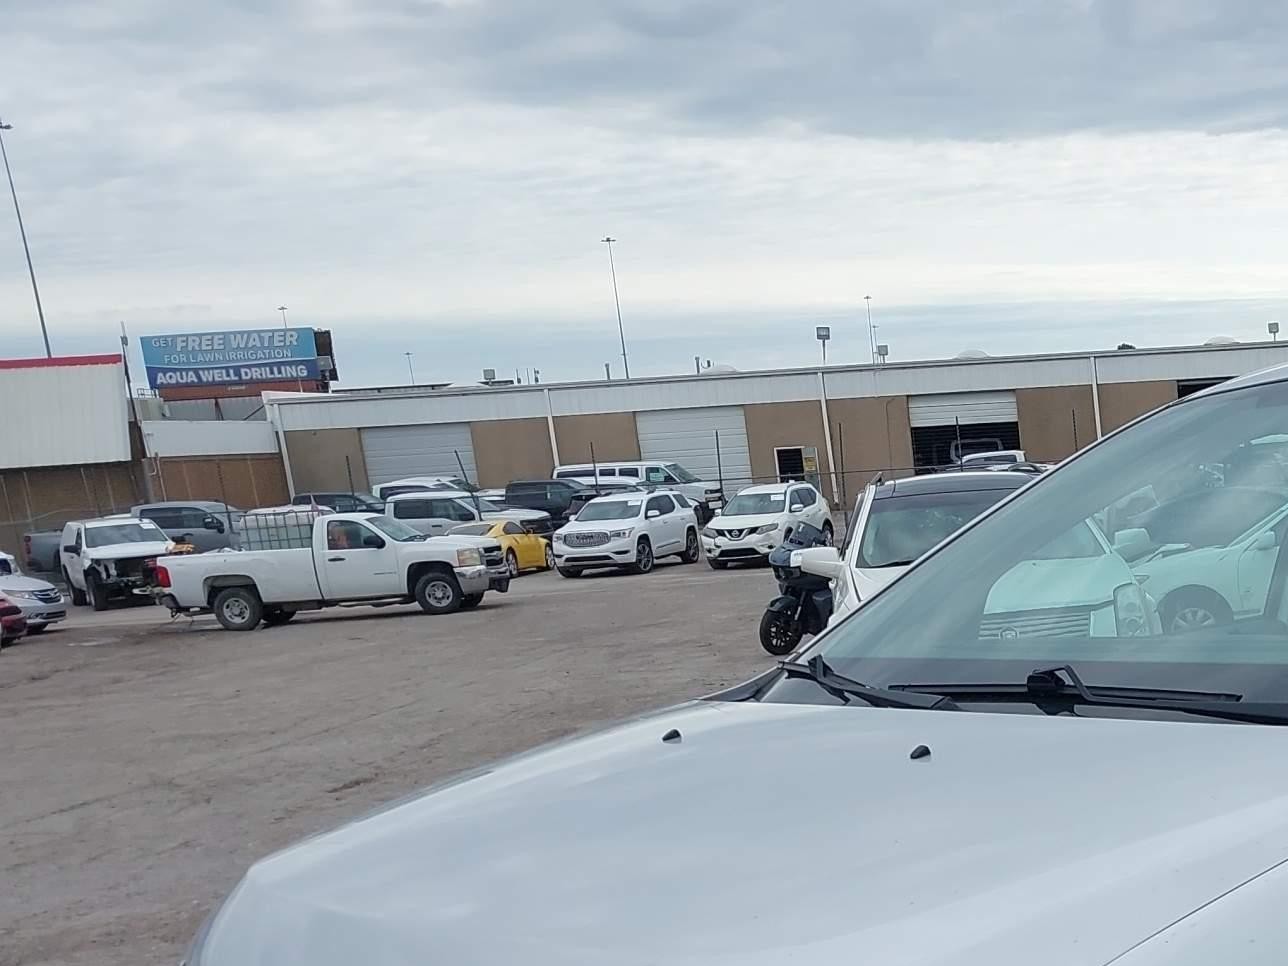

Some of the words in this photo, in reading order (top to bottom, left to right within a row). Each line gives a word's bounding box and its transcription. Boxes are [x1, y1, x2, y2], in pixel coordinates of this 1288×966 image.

[152, 337, 173, 347] GET
[176, 334, 225, 351] FREE
[229, 331, 298, 348] WATER
[164, 355, 187, 364] FOR
[189, 352, 223, 363] LAWN
[225, 349, 292, 361] IRRIGATION
[156, 371, 198, 384] AQUA
[200, 367, 239, 382] WELL
[240, 365, 308, 379] DRILLING
